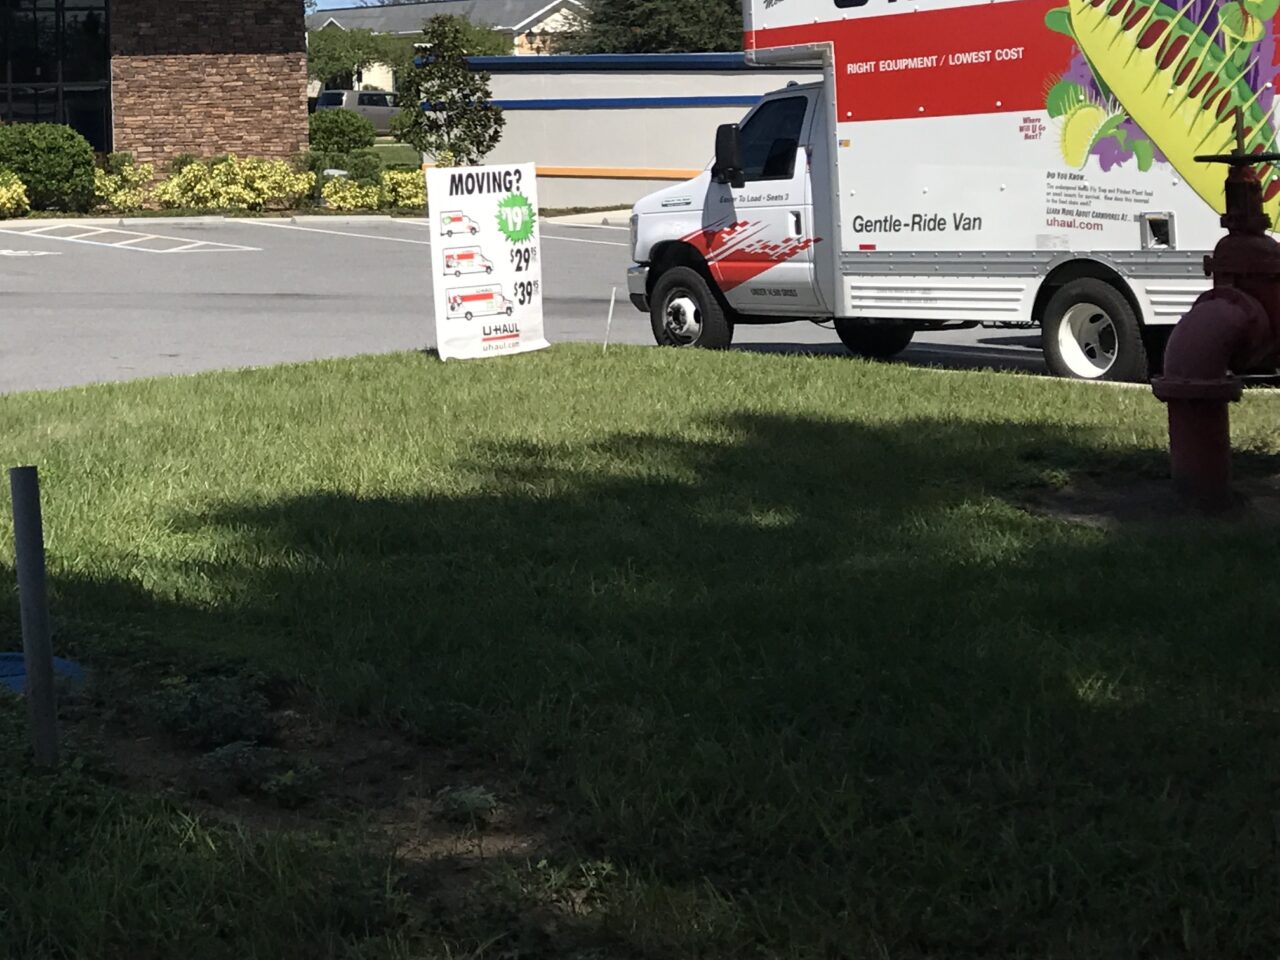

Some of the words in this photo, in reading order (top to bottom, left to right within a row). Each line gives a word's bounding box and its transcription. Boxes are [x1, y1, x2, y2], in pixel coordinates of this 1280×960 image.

[847, 61, 875, 75] RIGHT
[879, 56, 938, 72] EQUIPMENT
[948, 50, 992, 65] LOWEST
[995, 47, 1024, 61] COST
[449, 169, 522, 196] MOVING?
[739, 195, 746, 203] To
[766, 193, 783, 201] Seats
[852, 213, 947, 233] Gentle-Ride
[953, 213, 982, 231] Van
[1046, 217, 1103, 231] uhaul.com
